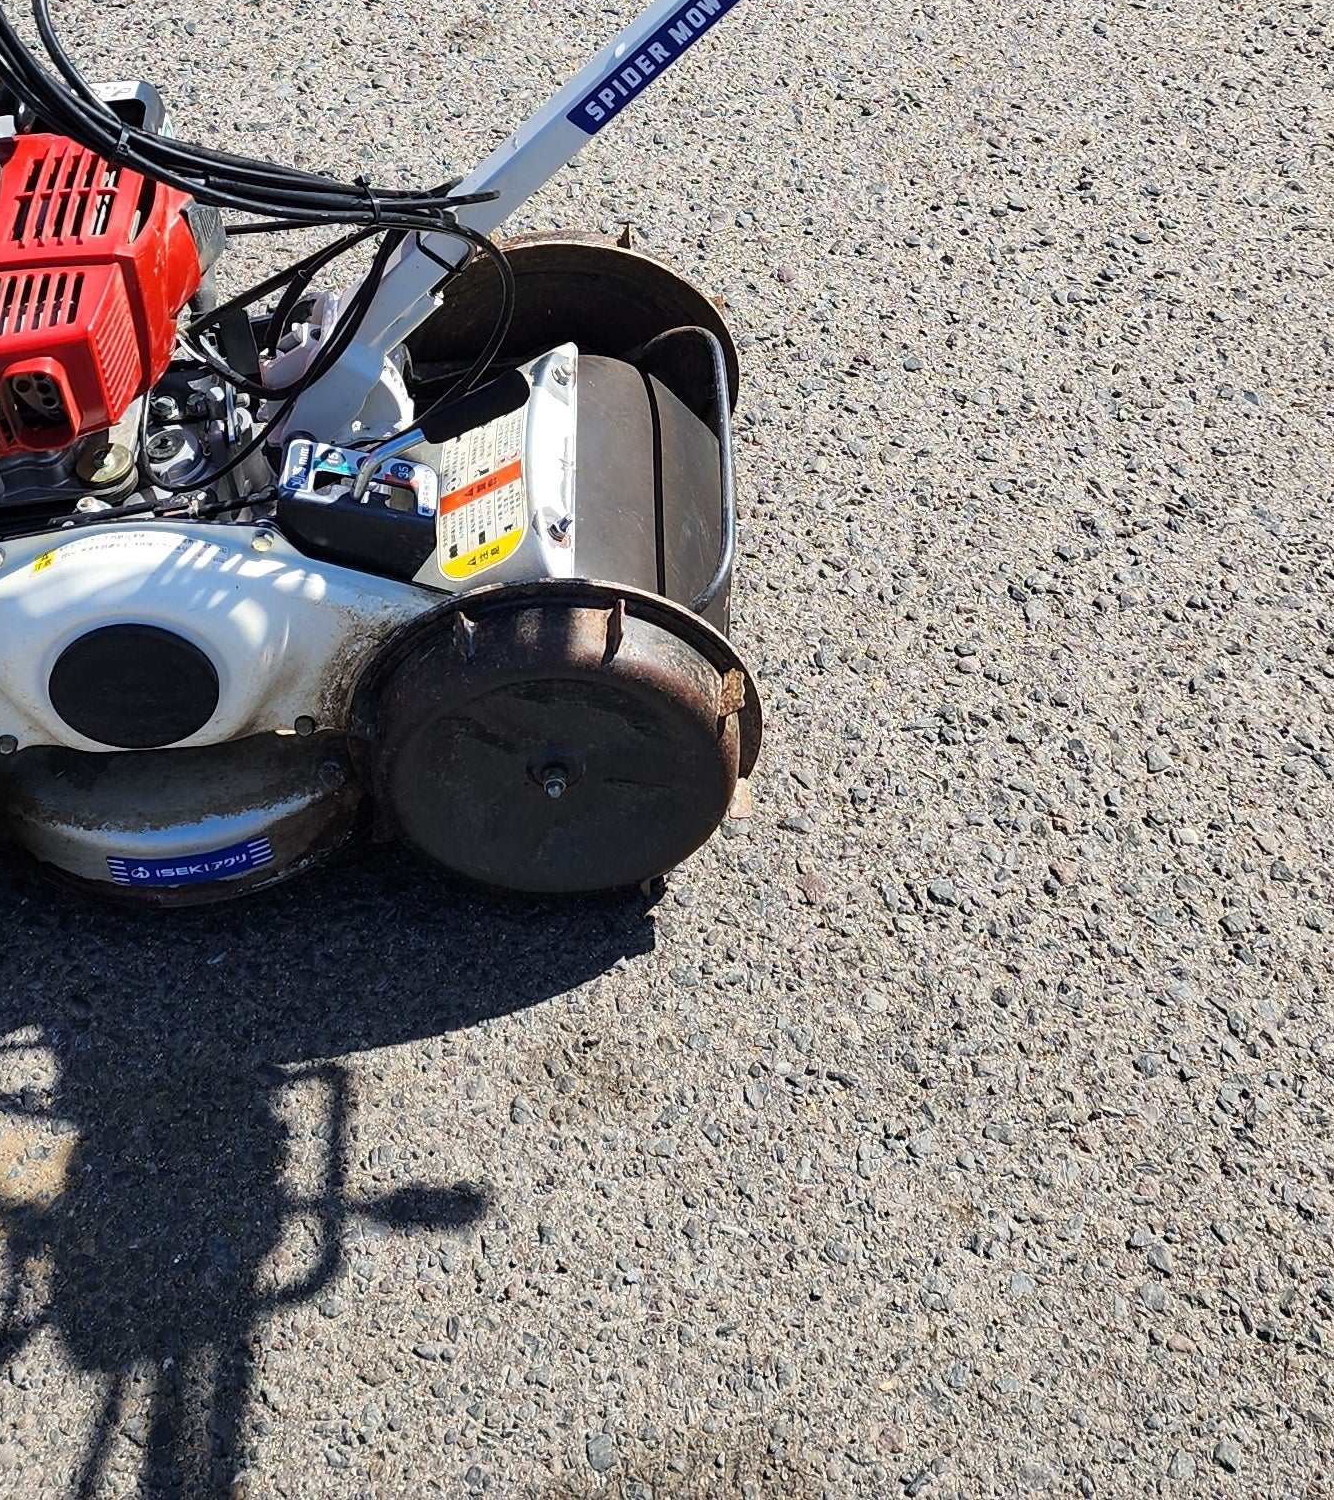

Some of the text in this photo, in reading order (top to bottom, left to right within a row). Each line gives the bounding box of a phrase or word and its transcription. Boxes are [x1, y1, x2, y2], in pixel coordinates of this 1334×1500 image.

[585, 41, 671, 122] SPIDER
[327, 452, 340, 464] 15
[397, 466, 409, 479] 35
